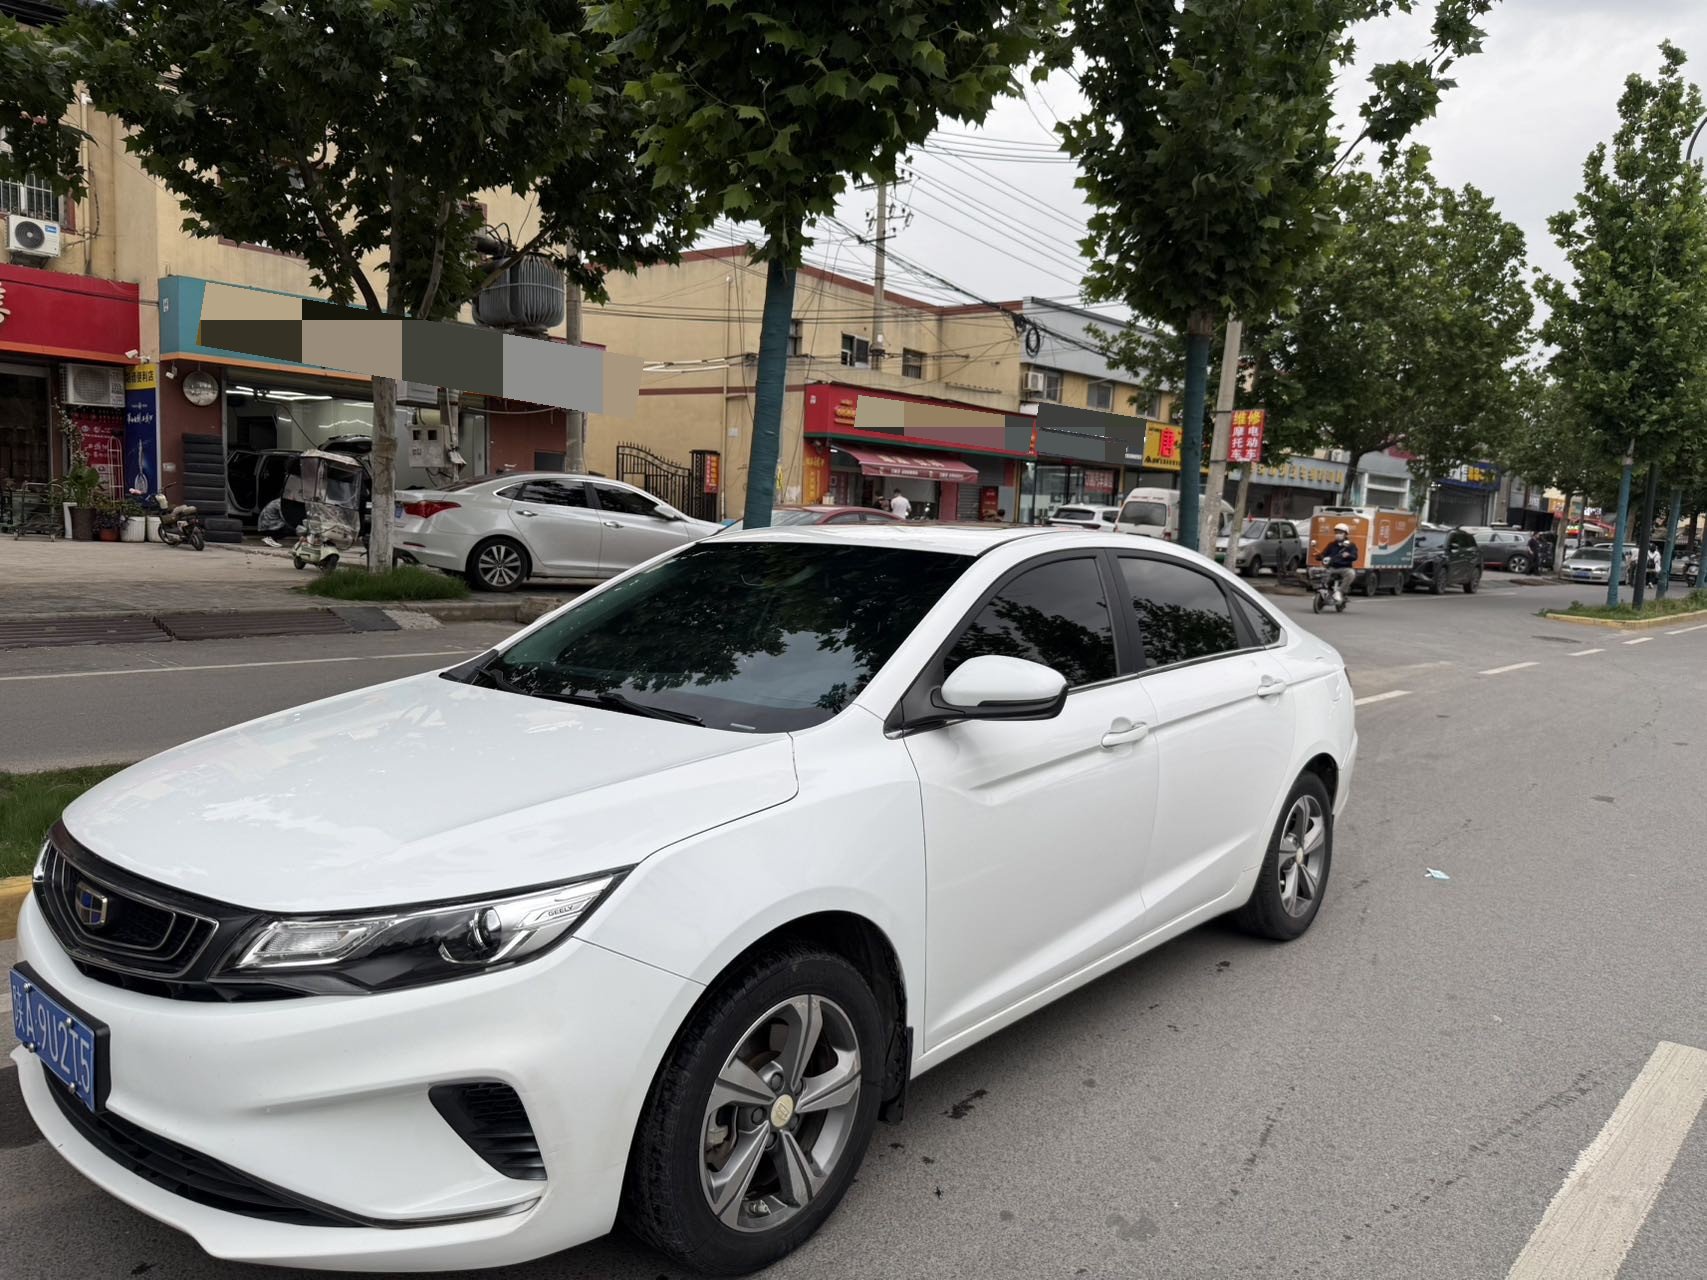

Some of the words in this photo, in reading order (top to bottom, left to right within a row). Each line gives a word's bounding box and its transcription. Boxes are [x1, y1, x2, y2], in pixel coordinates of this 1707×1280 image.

[1232, 411, 1261, 425] 维修
[1231, 426, 1245, 459] 摩托车
[1246, 426, 1259, 459] 电动车
[548, 905, 573, 916] GEELY
